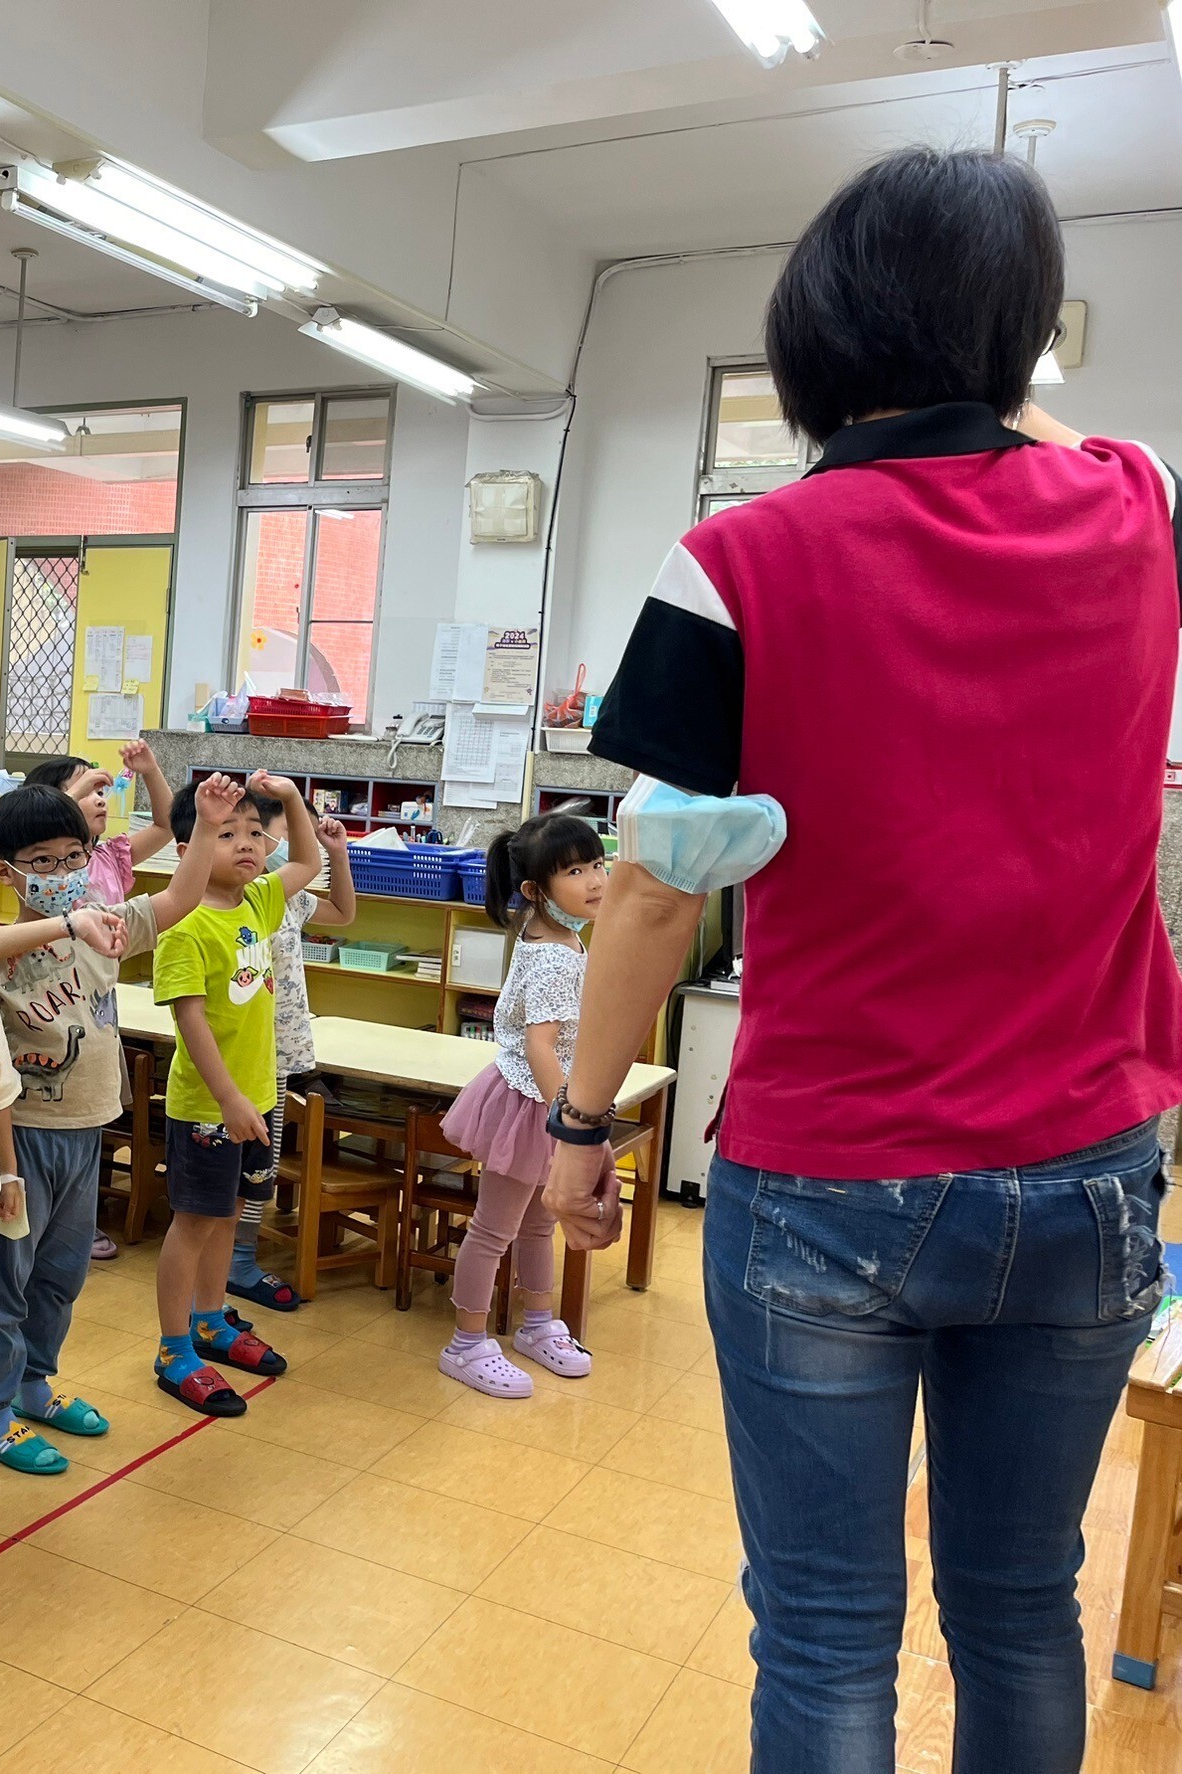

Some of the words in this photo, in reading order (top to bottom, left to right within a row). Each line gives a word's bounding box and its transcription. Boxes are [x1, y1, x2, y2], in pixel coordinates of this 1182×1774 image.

[504, 632, 525, 640] 2024
[235, 937, 273, 972] NIK
[16, 967, 86, 1031] ROAR!
